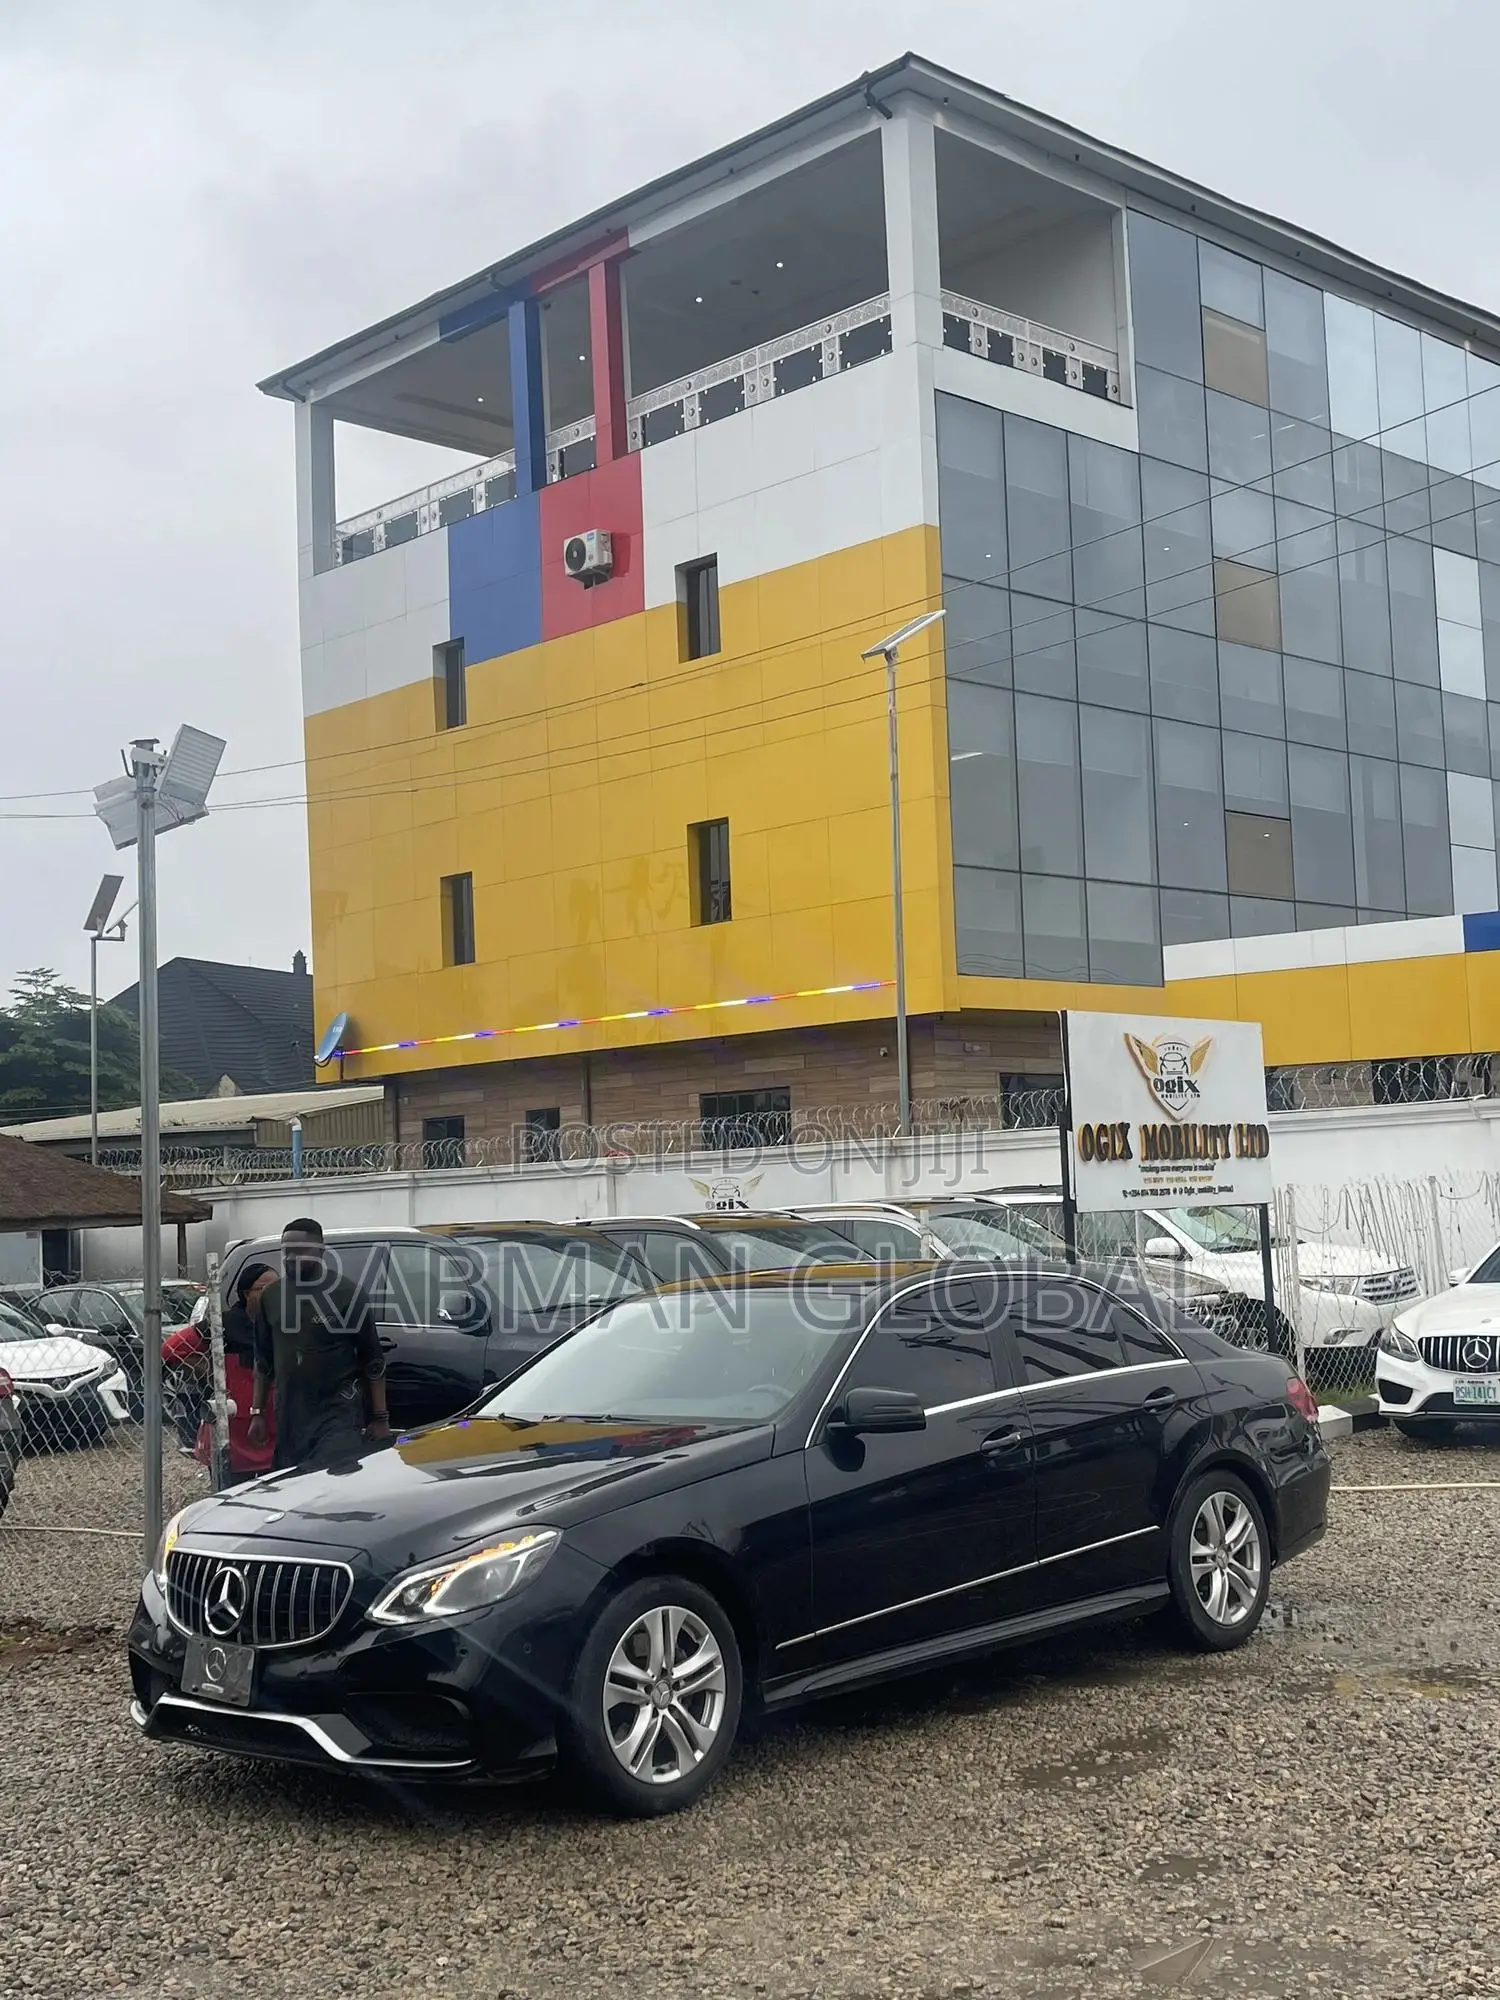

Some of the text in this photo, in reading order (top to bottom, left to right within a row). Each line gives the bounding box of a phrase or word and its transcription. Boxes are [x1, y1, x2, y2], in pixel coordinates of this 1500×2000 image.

[1078, 1122, 1270, 1162] OGIX MOBILITY LTD
